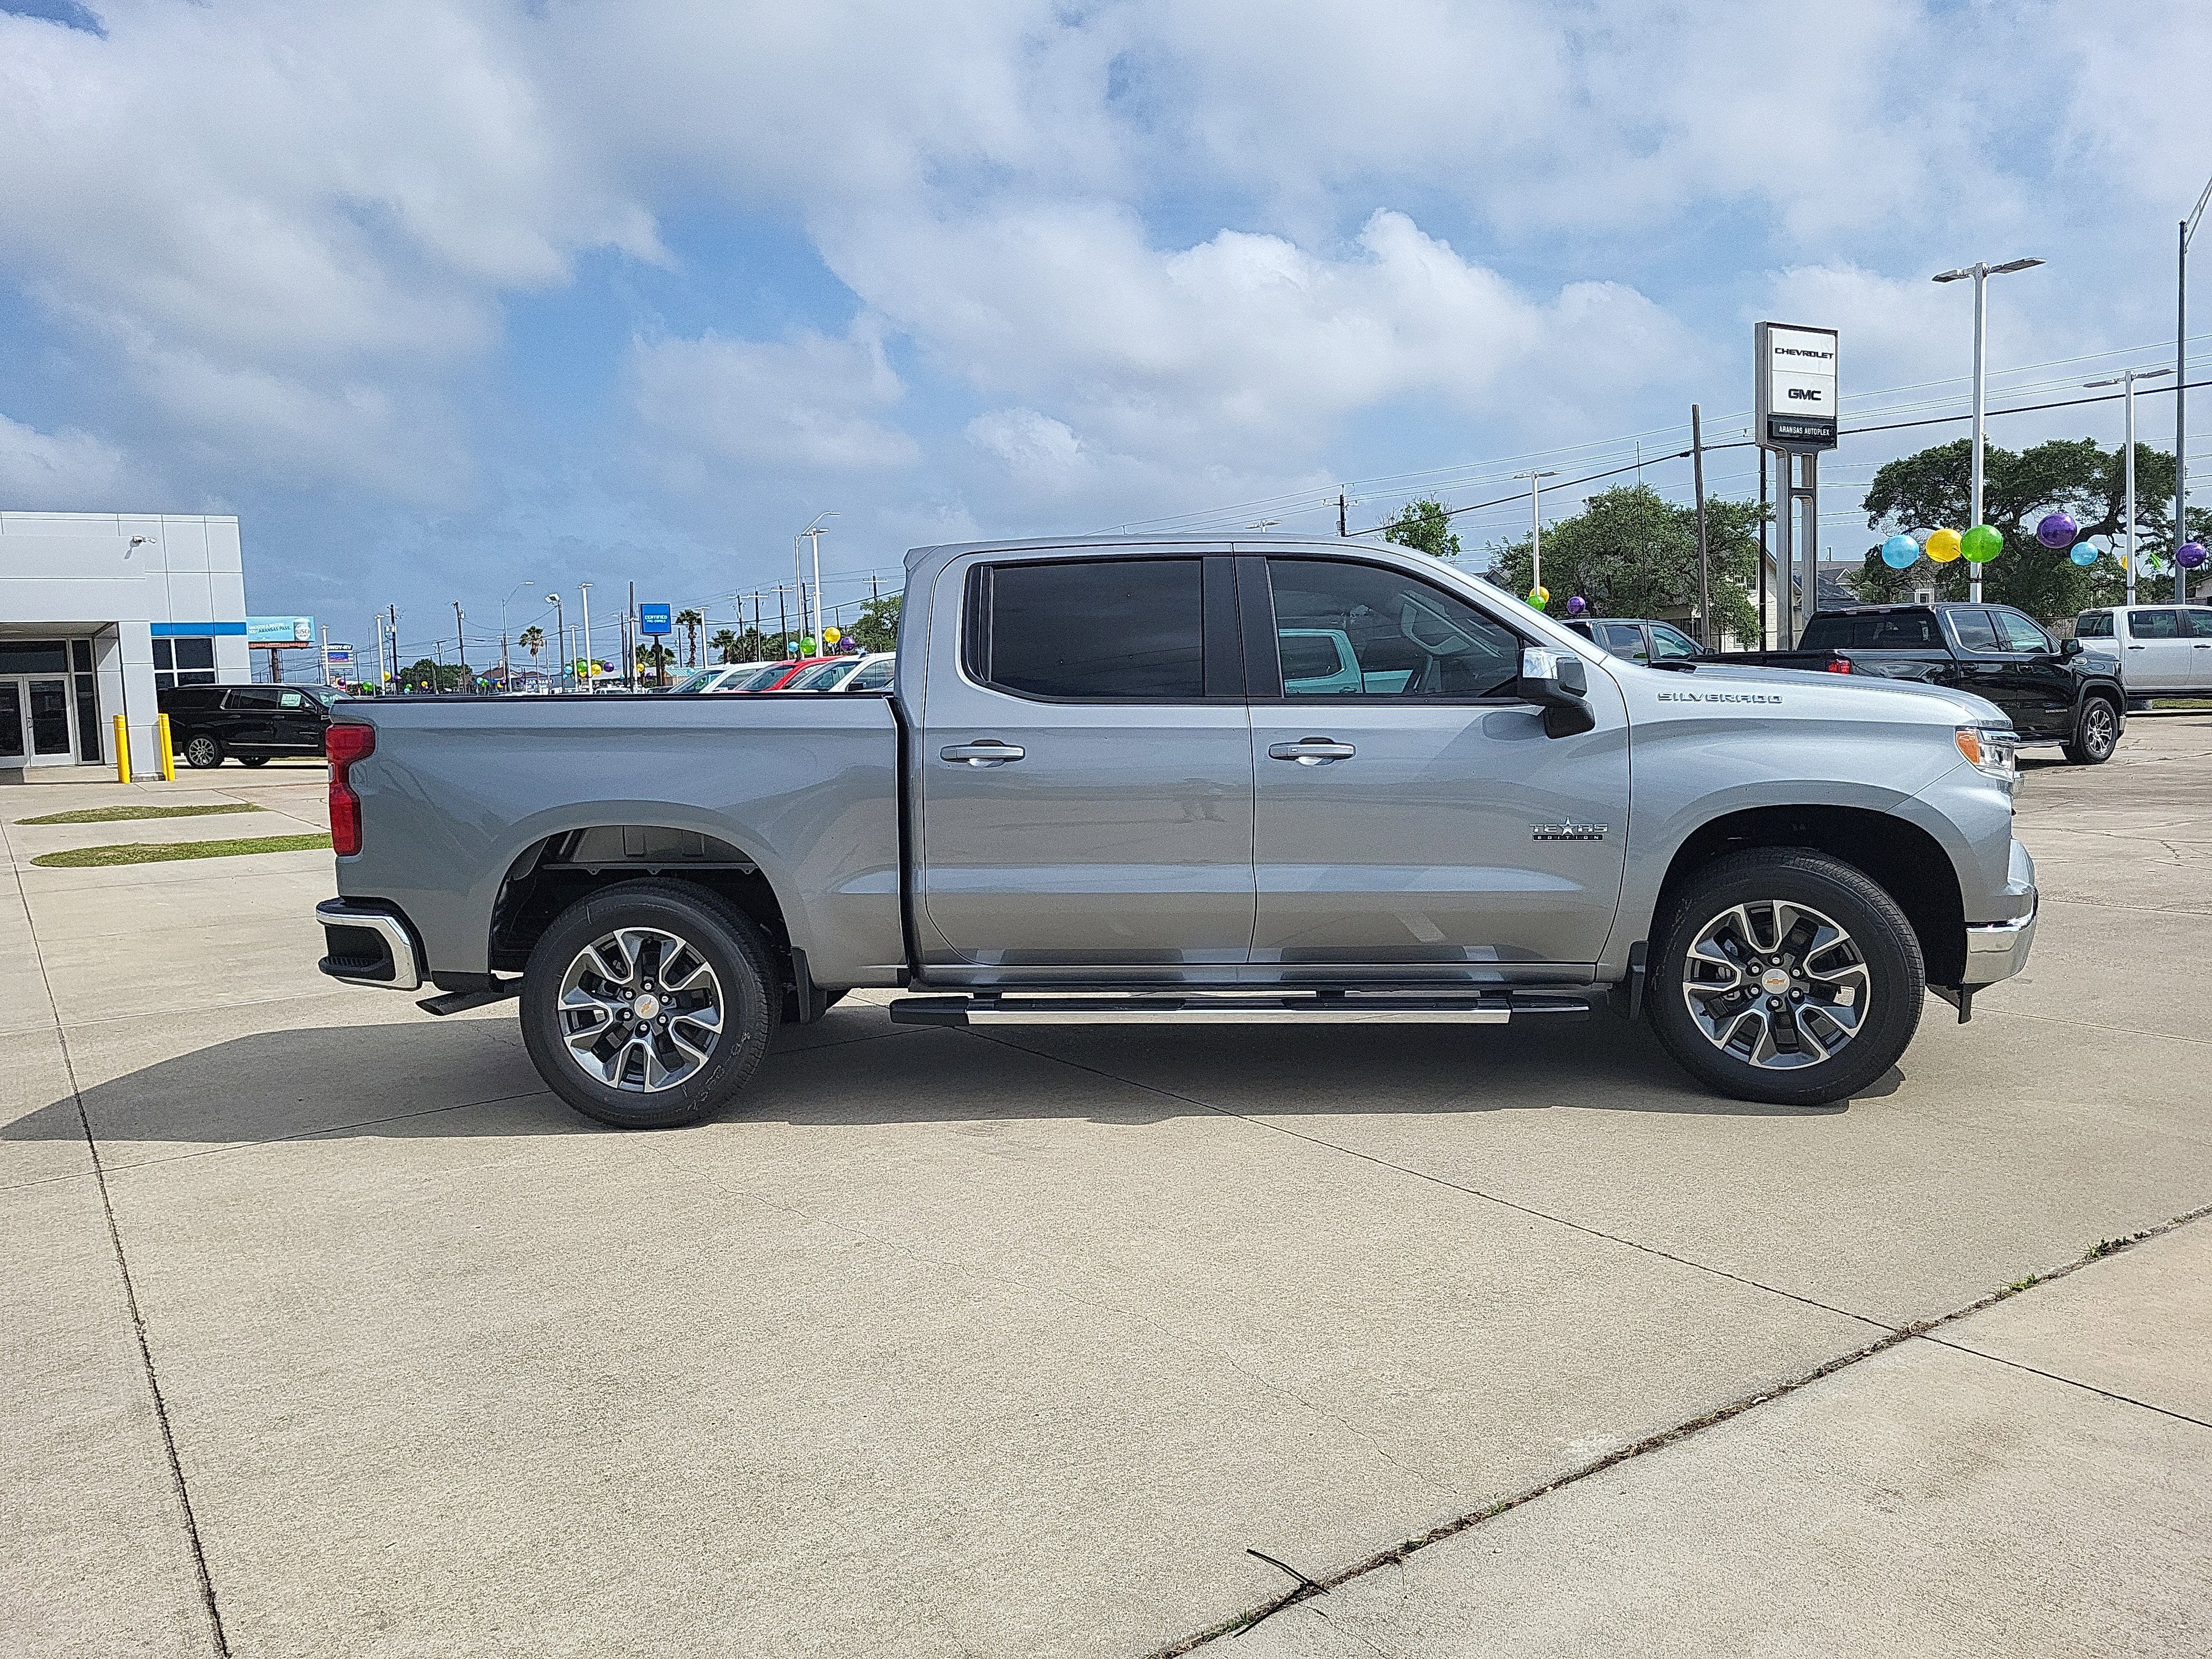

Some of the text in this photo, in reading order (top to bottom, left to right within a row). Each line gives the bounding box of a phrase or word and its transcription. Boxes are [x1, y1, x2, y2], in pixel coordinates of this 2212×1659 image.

[1775, 347, 1834, 359] CHEVROLET
[1788, 388, 1822, 401] GMC
[1778, 425, 1830, 436] ARANSAS AUTOPLEX
[1657, 692, 1783, 704] SILVERADO
